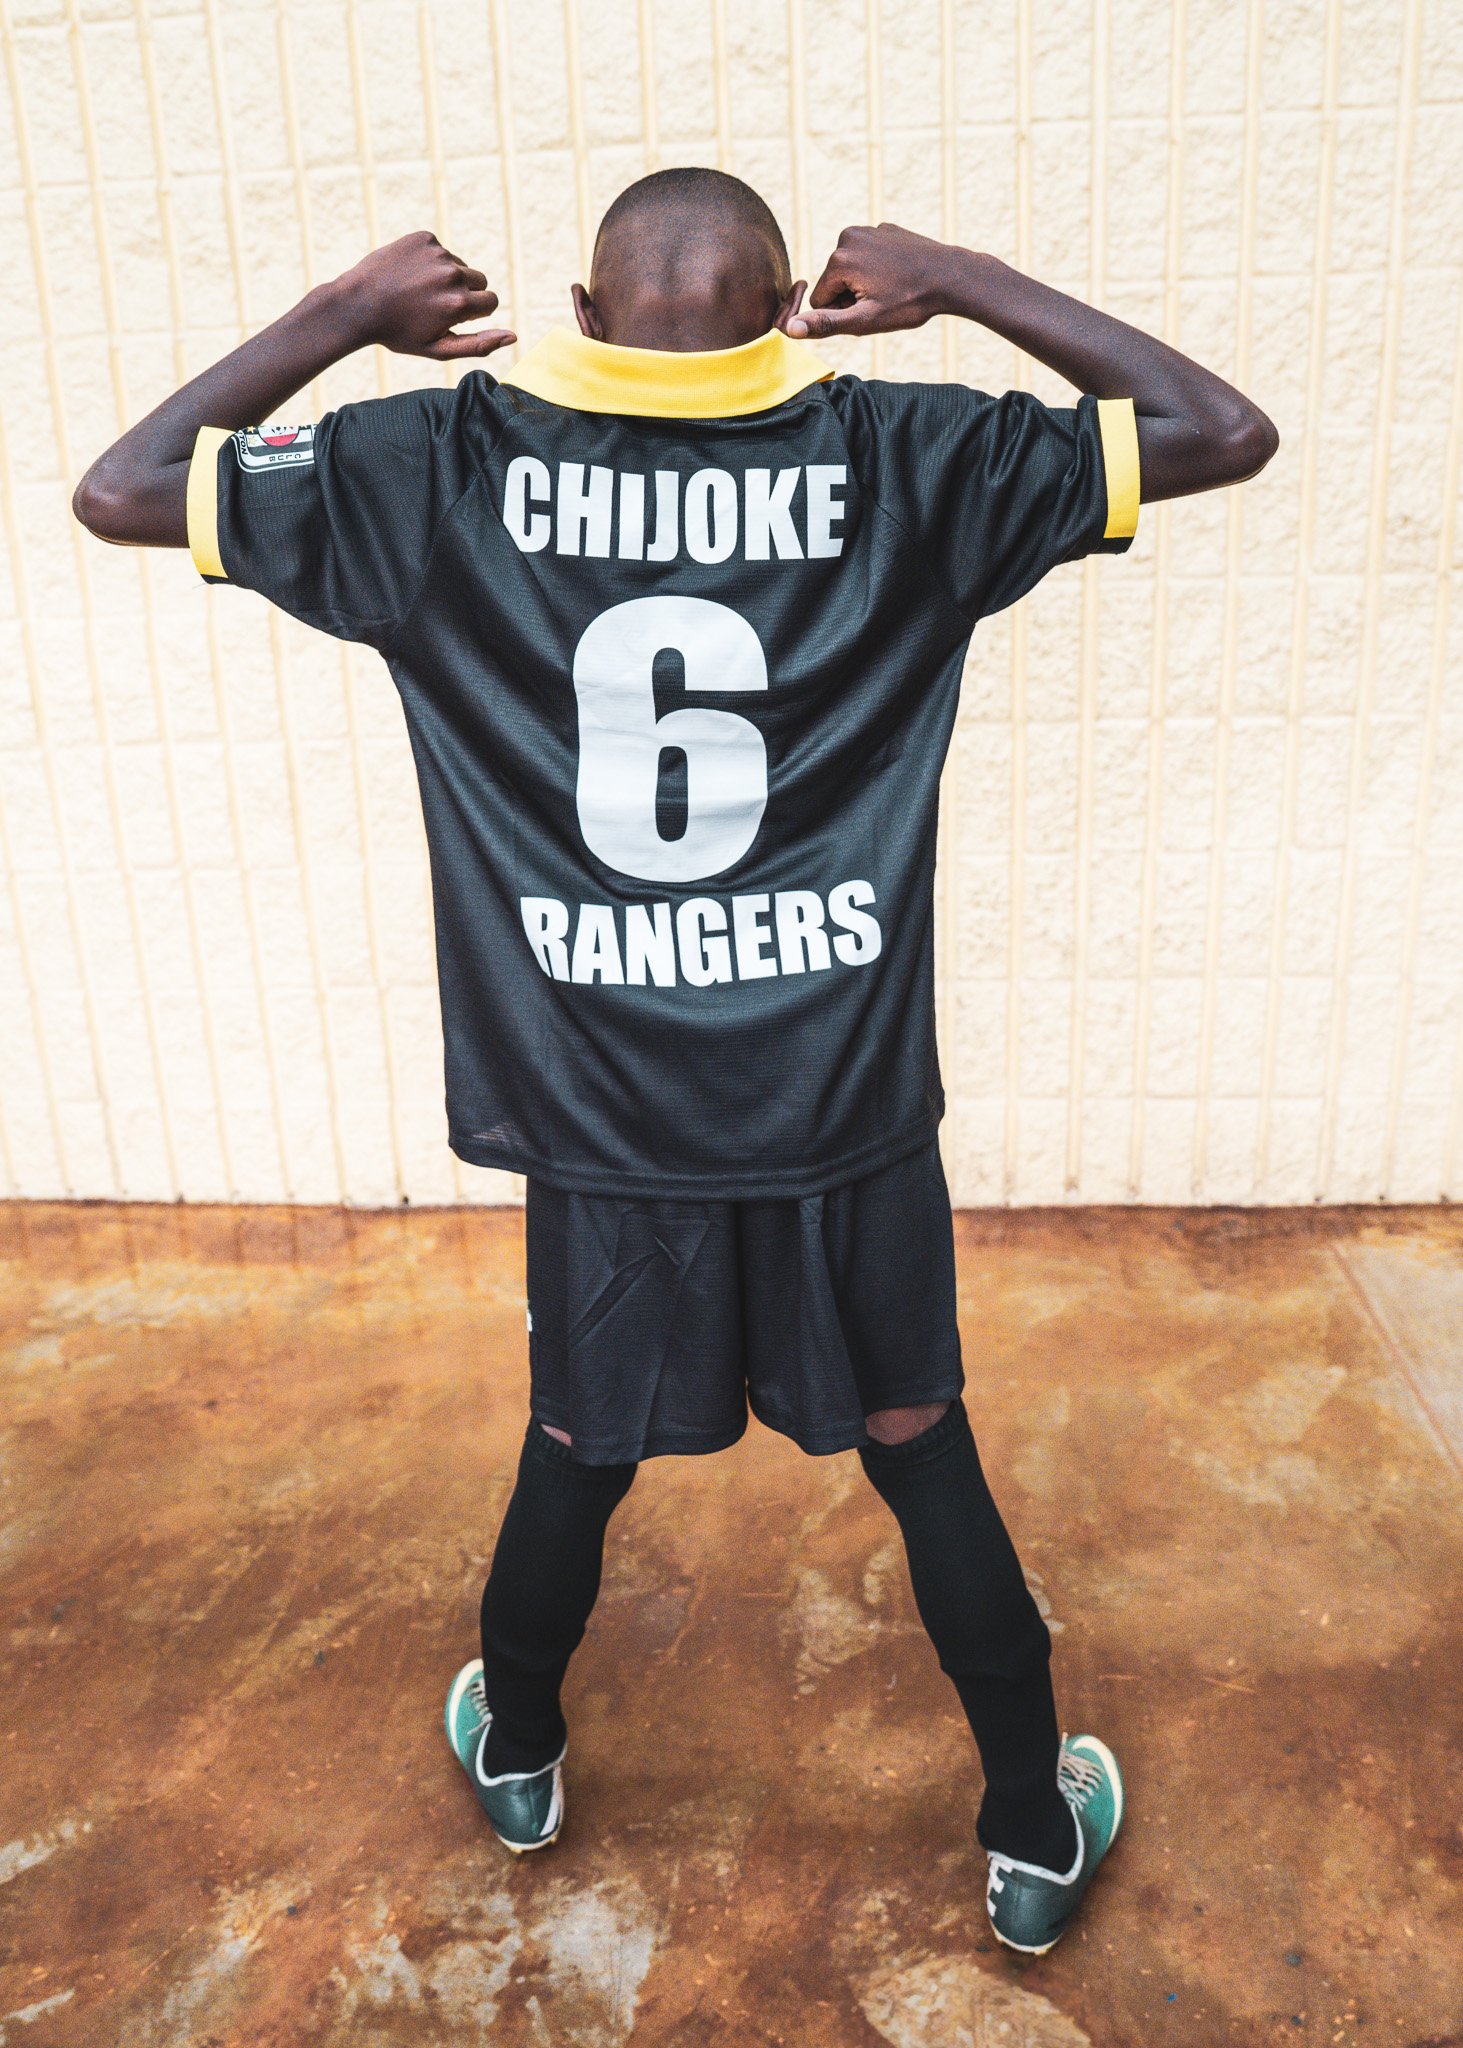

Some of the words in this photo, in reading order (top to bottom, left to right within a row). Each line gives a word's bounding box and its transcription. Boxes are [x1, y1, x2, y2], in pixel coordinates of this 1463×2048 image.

[503, 456, 847, 565] CHIJOKE
[572, 595, 769, 883] 6
[520, 880, 882, 988] RANGERS
